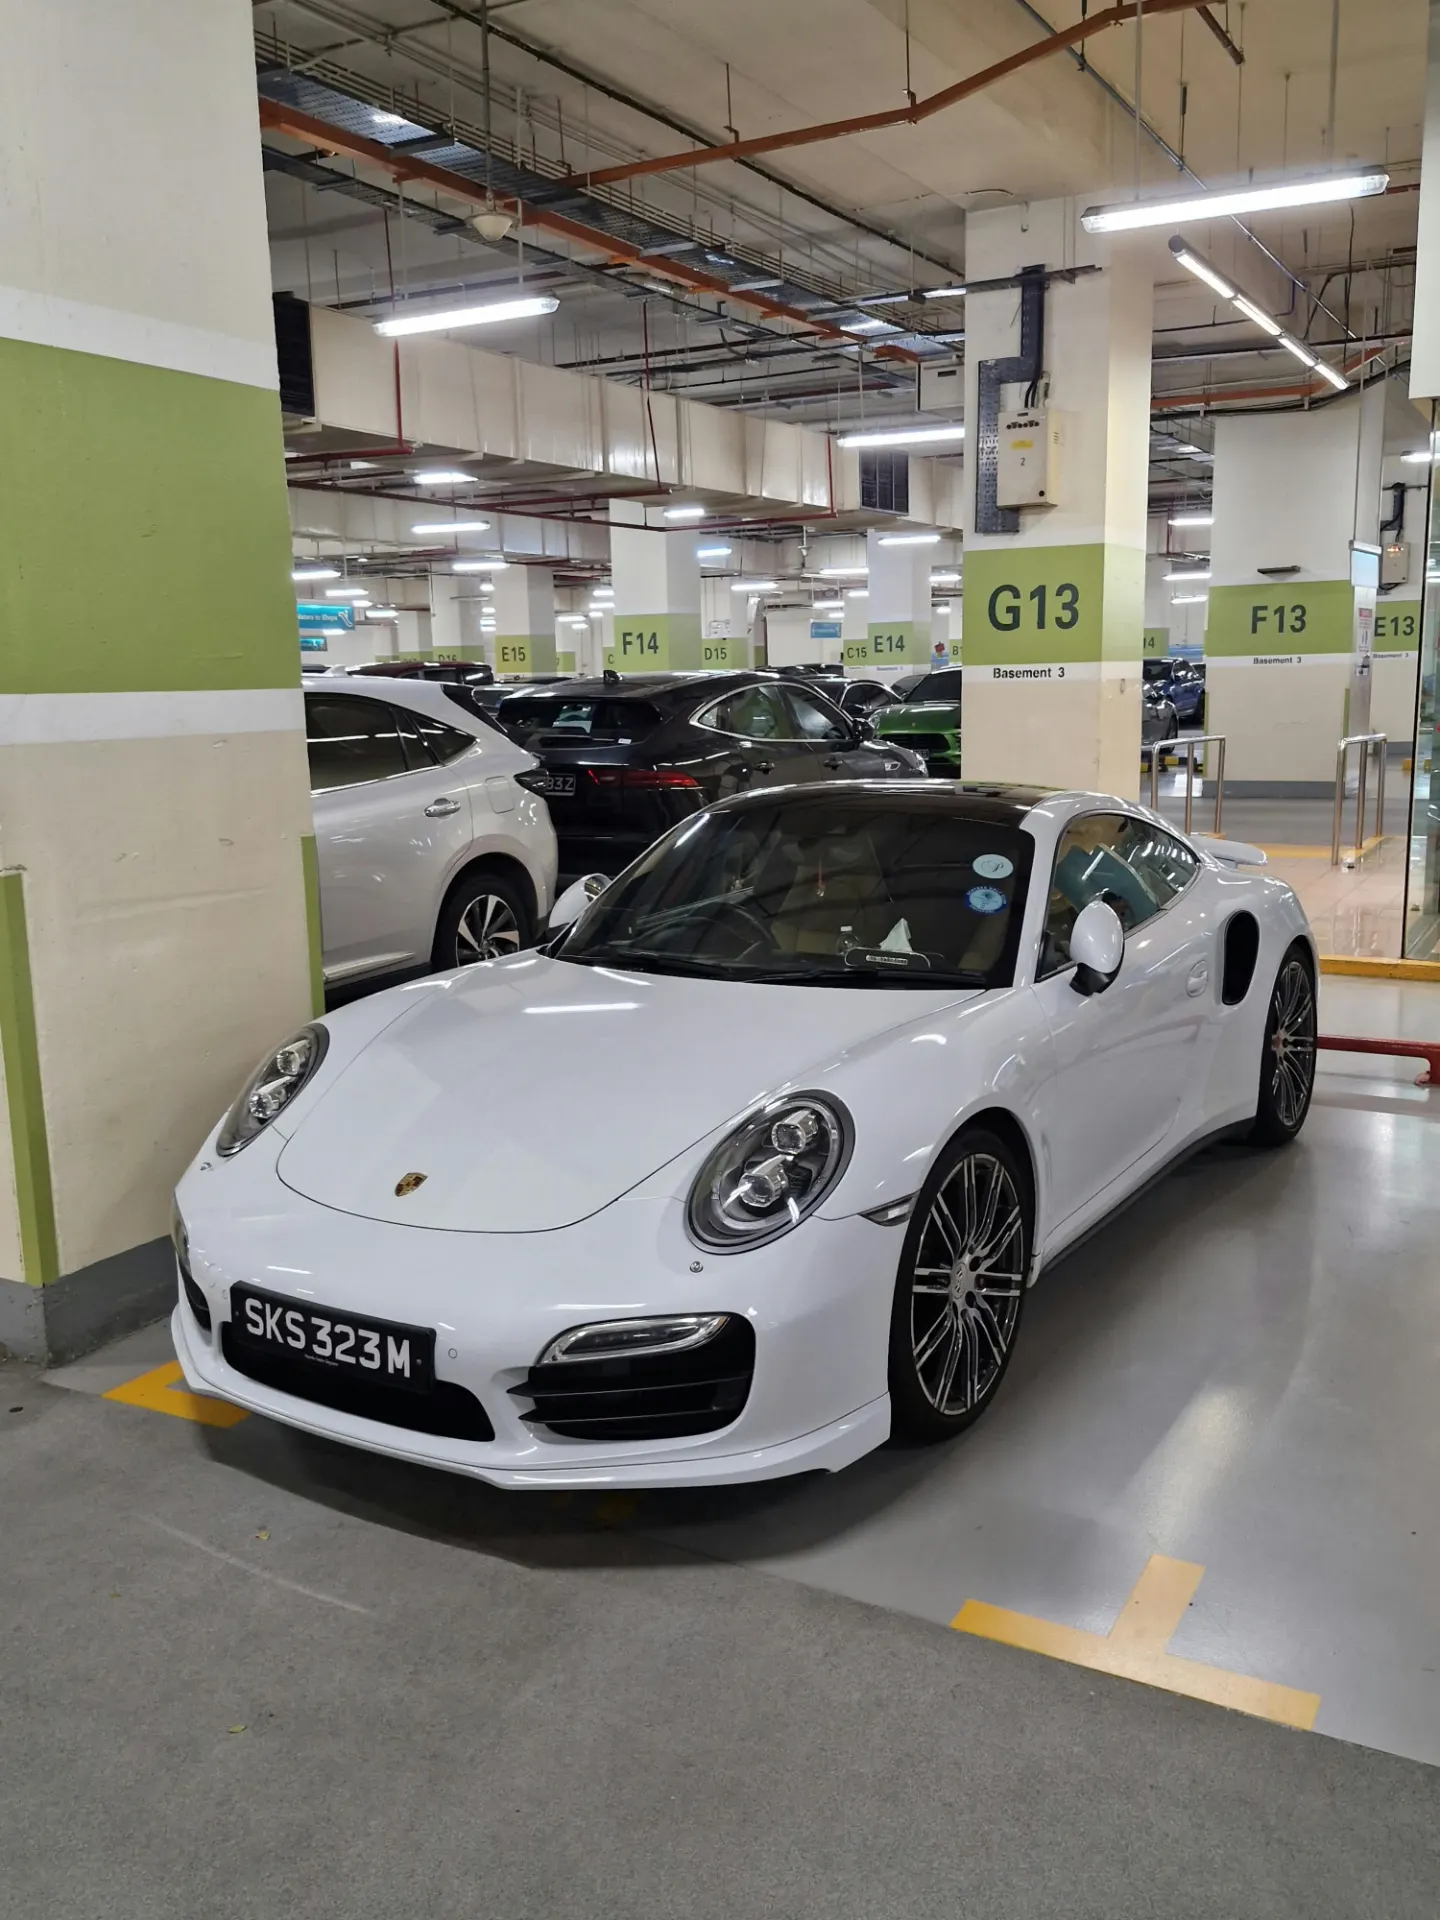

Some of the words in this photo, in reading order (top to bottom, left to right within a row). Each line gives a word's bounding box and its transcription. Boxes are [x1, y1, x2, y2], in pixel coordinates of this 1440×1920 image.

[1020, 457, 1026, 466] 2
[988, 583, 1080, 632] G13
[1251, 604, 1306, 635] F13
[1374, 616, 1415, 637] E13
[622, 632, 659, 655] F14
[874, 634, 905, 653] E14
[1143, 636, 1155, 649] 14
[501, 646, 526, 662] E15
[704, 647, 727, 660] D15
[847, 647, 867, 659] C15
[1253, 656, 1294, 666] Basement
[1296, 656, 1302, 664] 3
[993, 666, 1052, 680] Basement
[1058, 666, 1065, 678] 3
